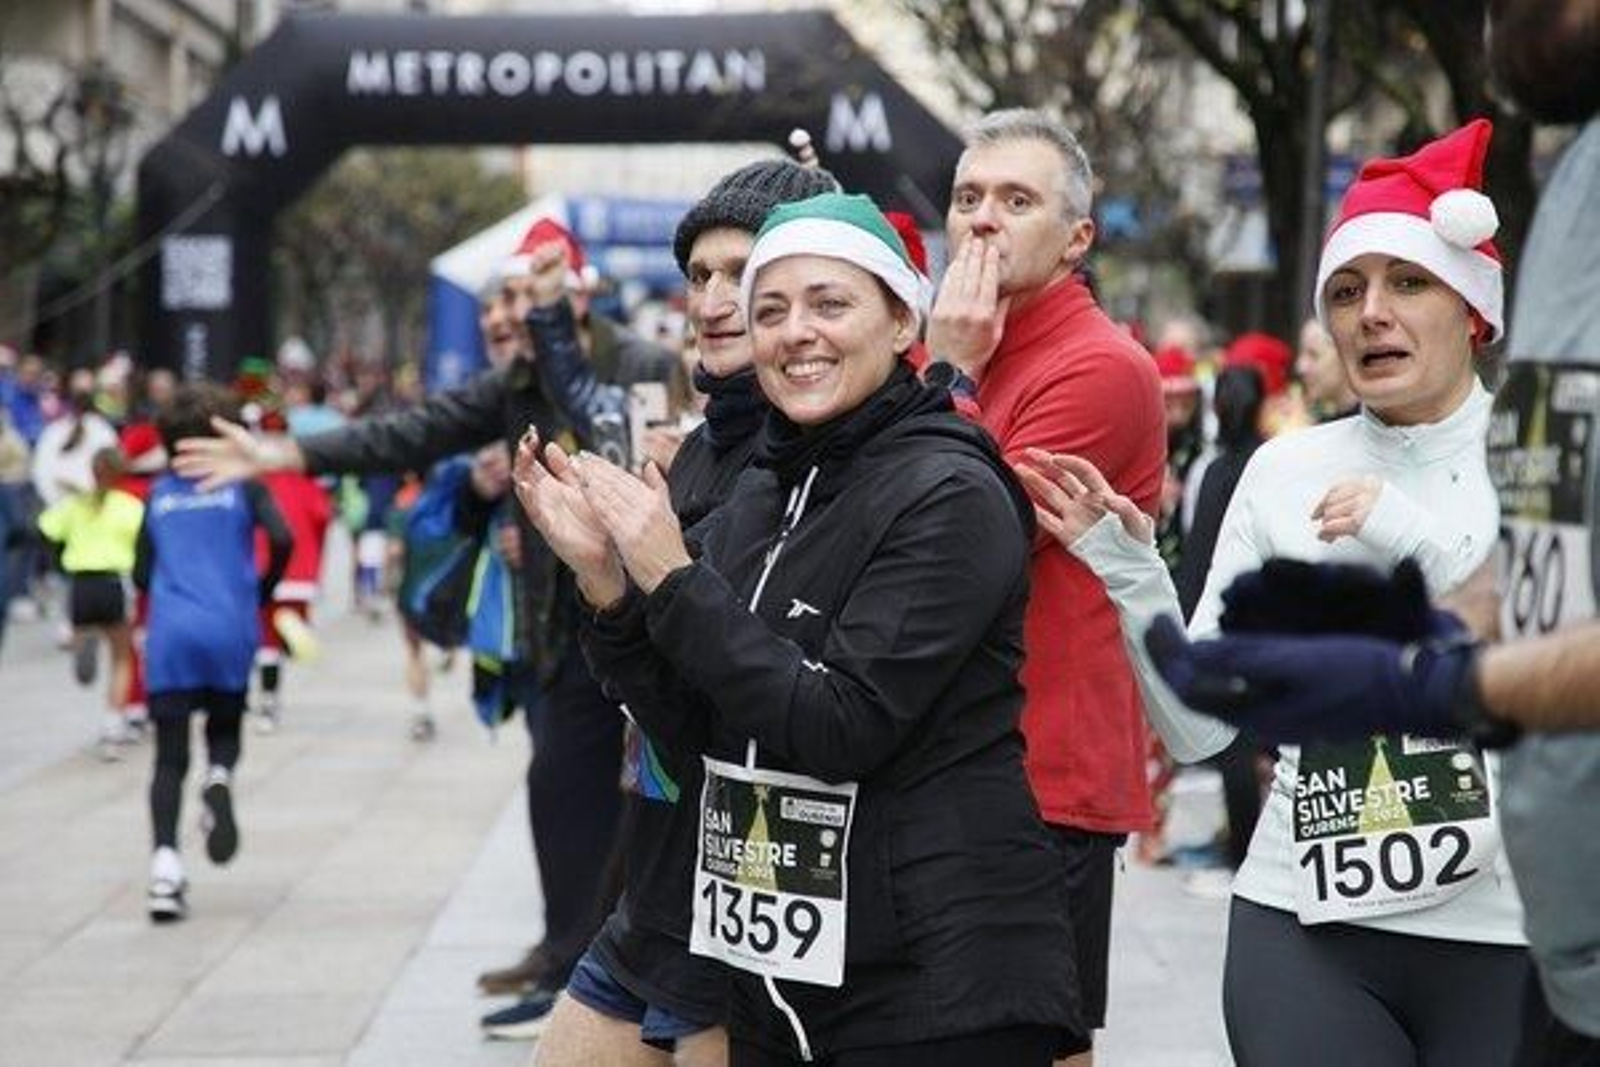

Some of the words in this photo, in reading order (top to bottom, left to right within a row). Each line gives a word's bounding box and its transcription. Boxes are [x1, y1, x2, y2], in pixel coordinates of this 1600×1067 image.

[347, 50, 766, 95] METROPOLITAN
[221, 95, 286, 156] M
[827, 92, 892, 152] M
[1297, 767, 1346, 797] SAN
[1297, 776, 1431, 823] SILVESTRE
[705, 807, 731, 833] SAN
[705, 834, 797, 867] SILVESTRE
[1300, 825, 1480, 902] 1502
[702, 879, 823, 960] 1359
